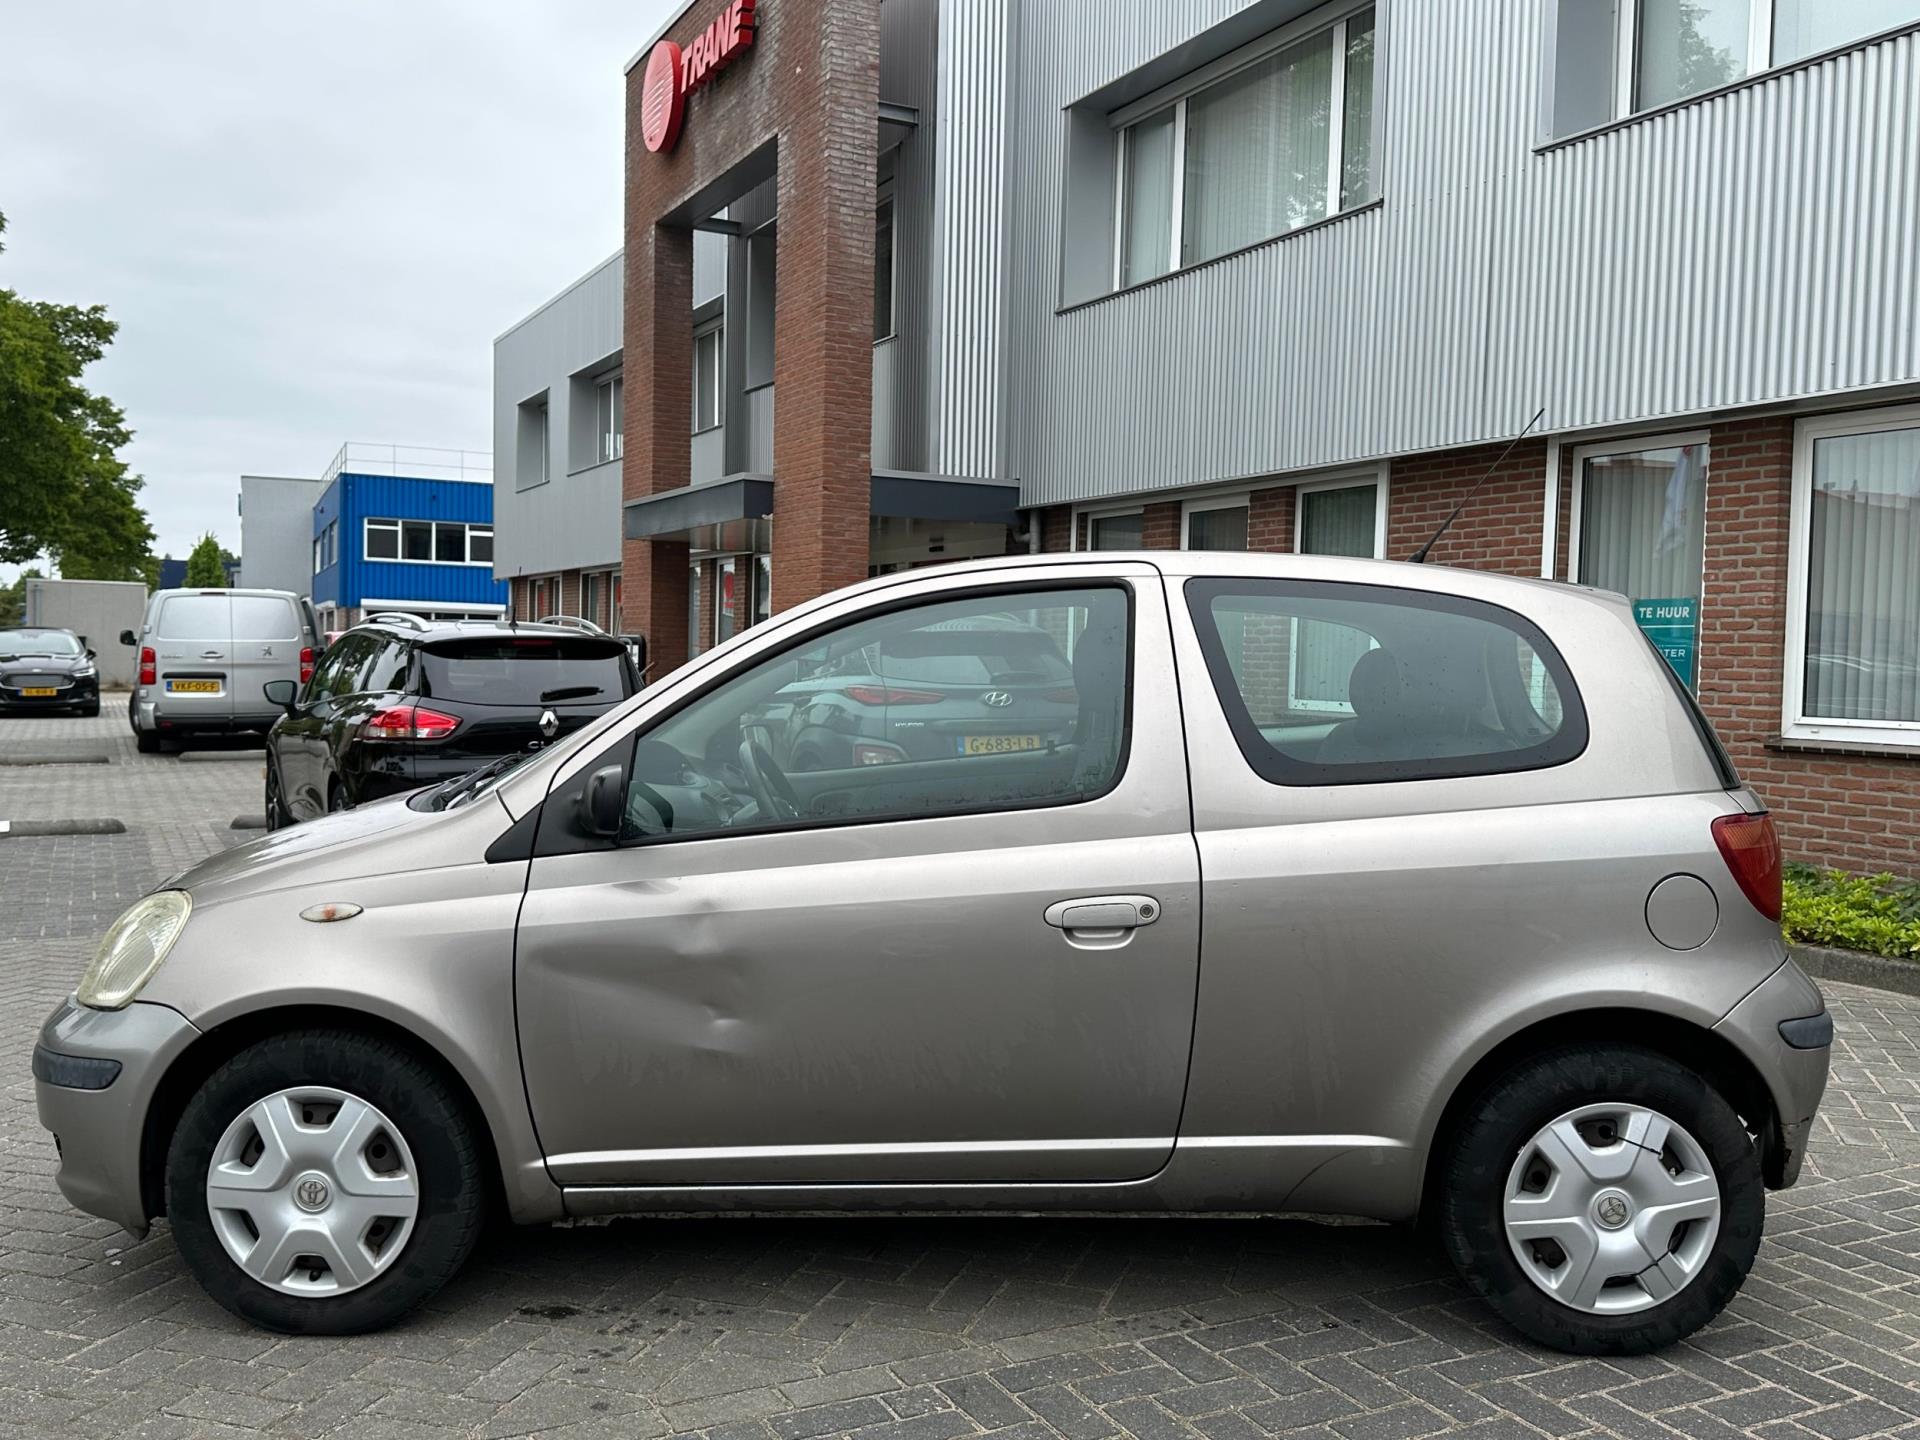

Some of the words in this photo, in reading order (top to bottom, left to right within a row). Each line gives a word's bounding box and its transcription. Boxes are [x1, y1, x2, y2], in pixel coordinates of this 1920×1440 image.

[680, 0, 744, 94] TRANE
[1639, 608, 1653, 618] TE
[1656, 607, 1690, 618] HUUR
[1661, 649, 1686, 657] TER
